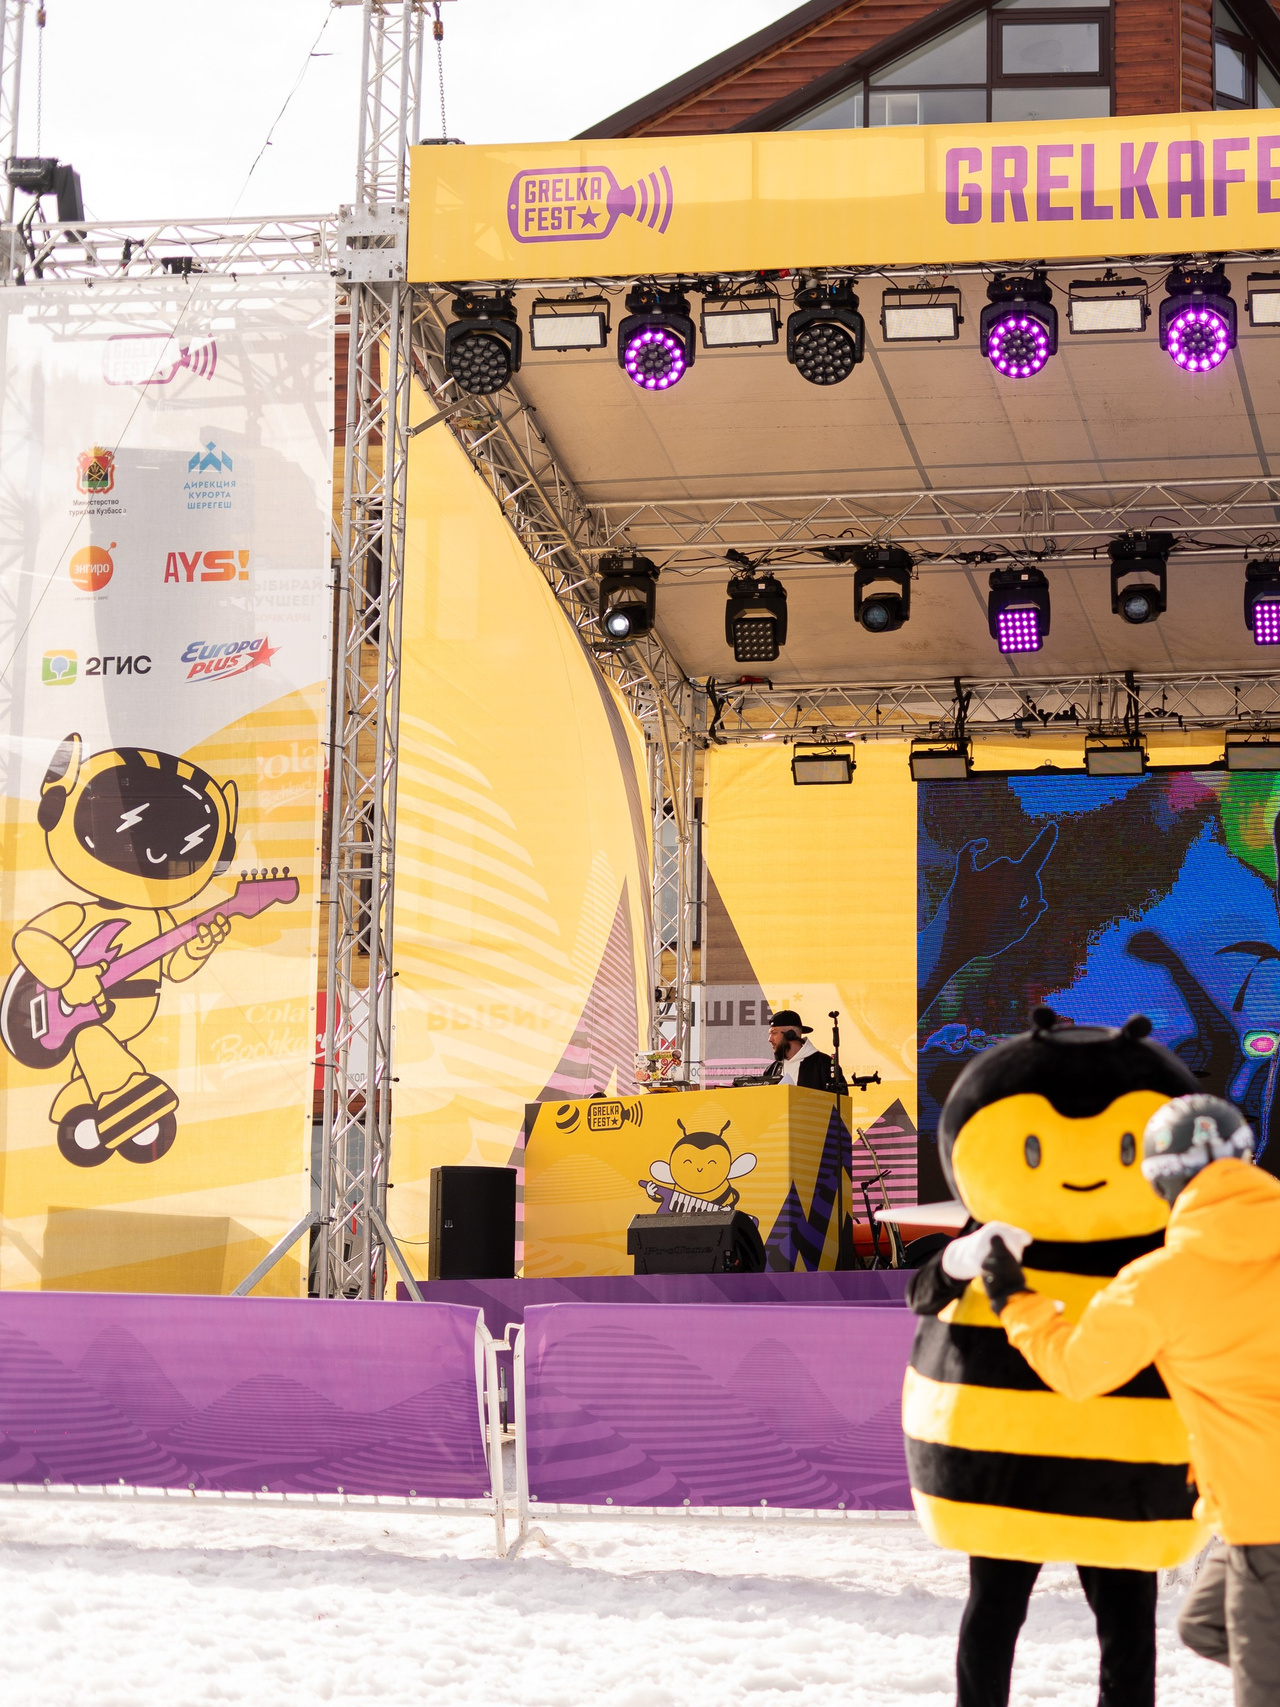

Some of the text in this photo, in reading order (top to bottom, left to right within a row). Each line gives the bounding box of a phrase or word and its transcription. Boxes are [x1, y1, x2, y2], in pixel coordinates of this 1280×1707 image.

[525, 177, 602, 204] GRELKA
[524, 206, 577, 232] FEST
[183, 480, 236, 490] ДИРЕКЦИЯ
[188, 491, 231, 499] КУРОРТА
[97, 507, 127, 515] Кузбасса
[187, 501, 232, 509] ШЕРЕГЕШ
[74, 563, 110, 576] энгиро
[164, 550, 250, 583] AYS!
[85, 655, 152, 676] 2ГИС
[593, 1105, 620, 1117] GRELKA
[593, 1117, 611, 1127] FEST
